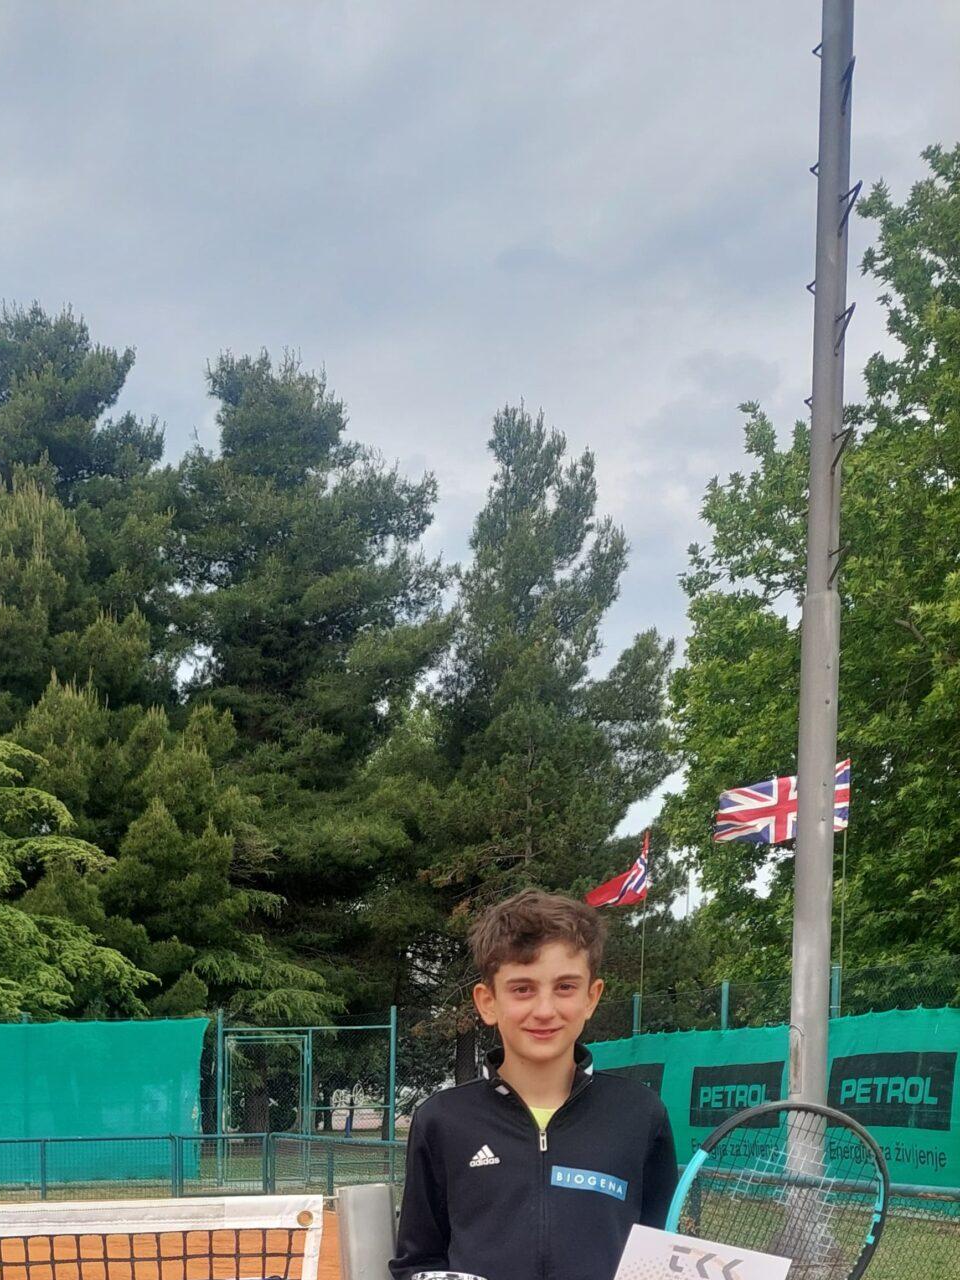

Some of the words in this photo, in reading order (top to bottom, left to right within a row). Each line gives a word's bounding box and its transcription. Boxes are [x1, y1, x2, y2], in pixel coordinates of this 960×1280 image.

[700, 1083, 772, 1108] PETROL
[840, 1076, 938, 1105] PETROL
[469, 1156, 501, 1168] adidas
[895, 1142, 947, 1172] življenje
[556, 1171, 623, 1195] BIOGENA
